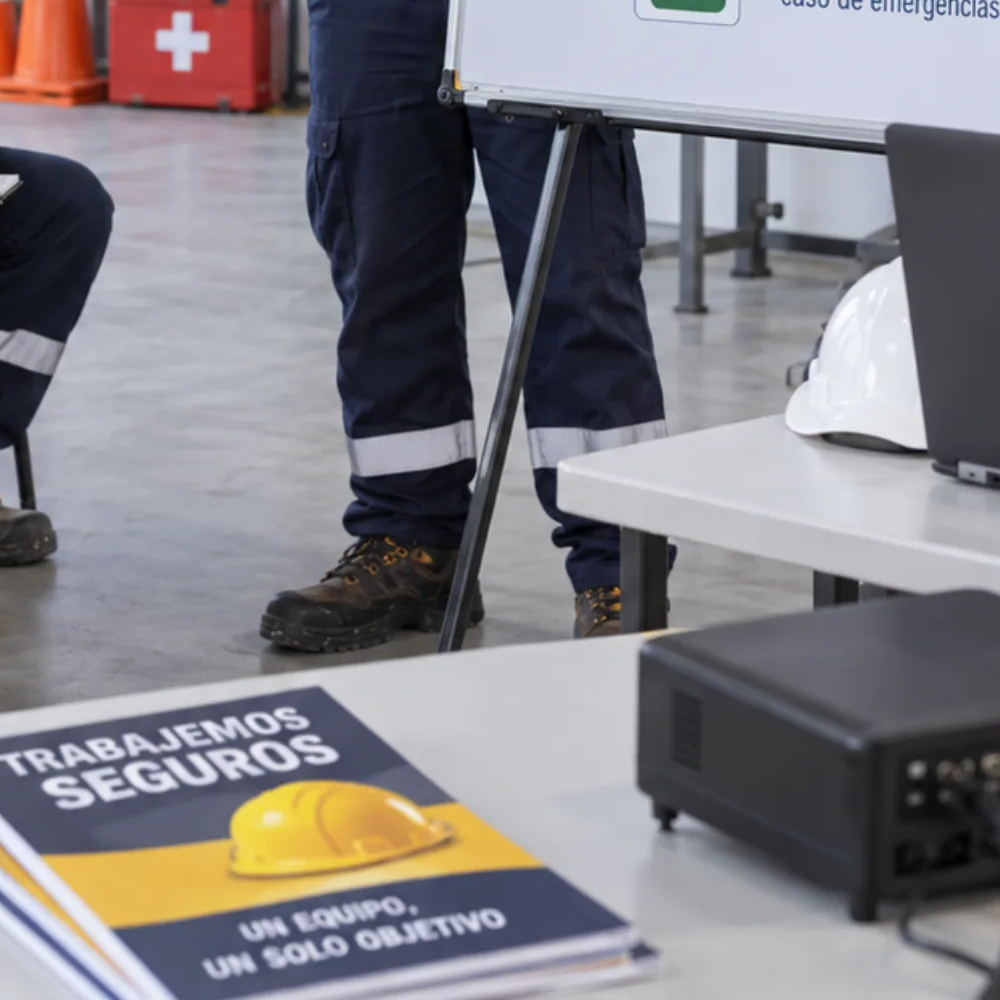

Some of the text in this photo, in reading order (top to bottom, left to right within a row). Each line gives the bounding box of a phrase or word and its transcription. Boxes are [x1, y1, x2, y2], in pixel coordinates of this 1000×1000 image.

[40, 733, 340, 810] SEGUROS
[201, 908, 507, 980] UN SOLO OBJETIVO
[238, 896, 419, 943] UN EQUIPO,
